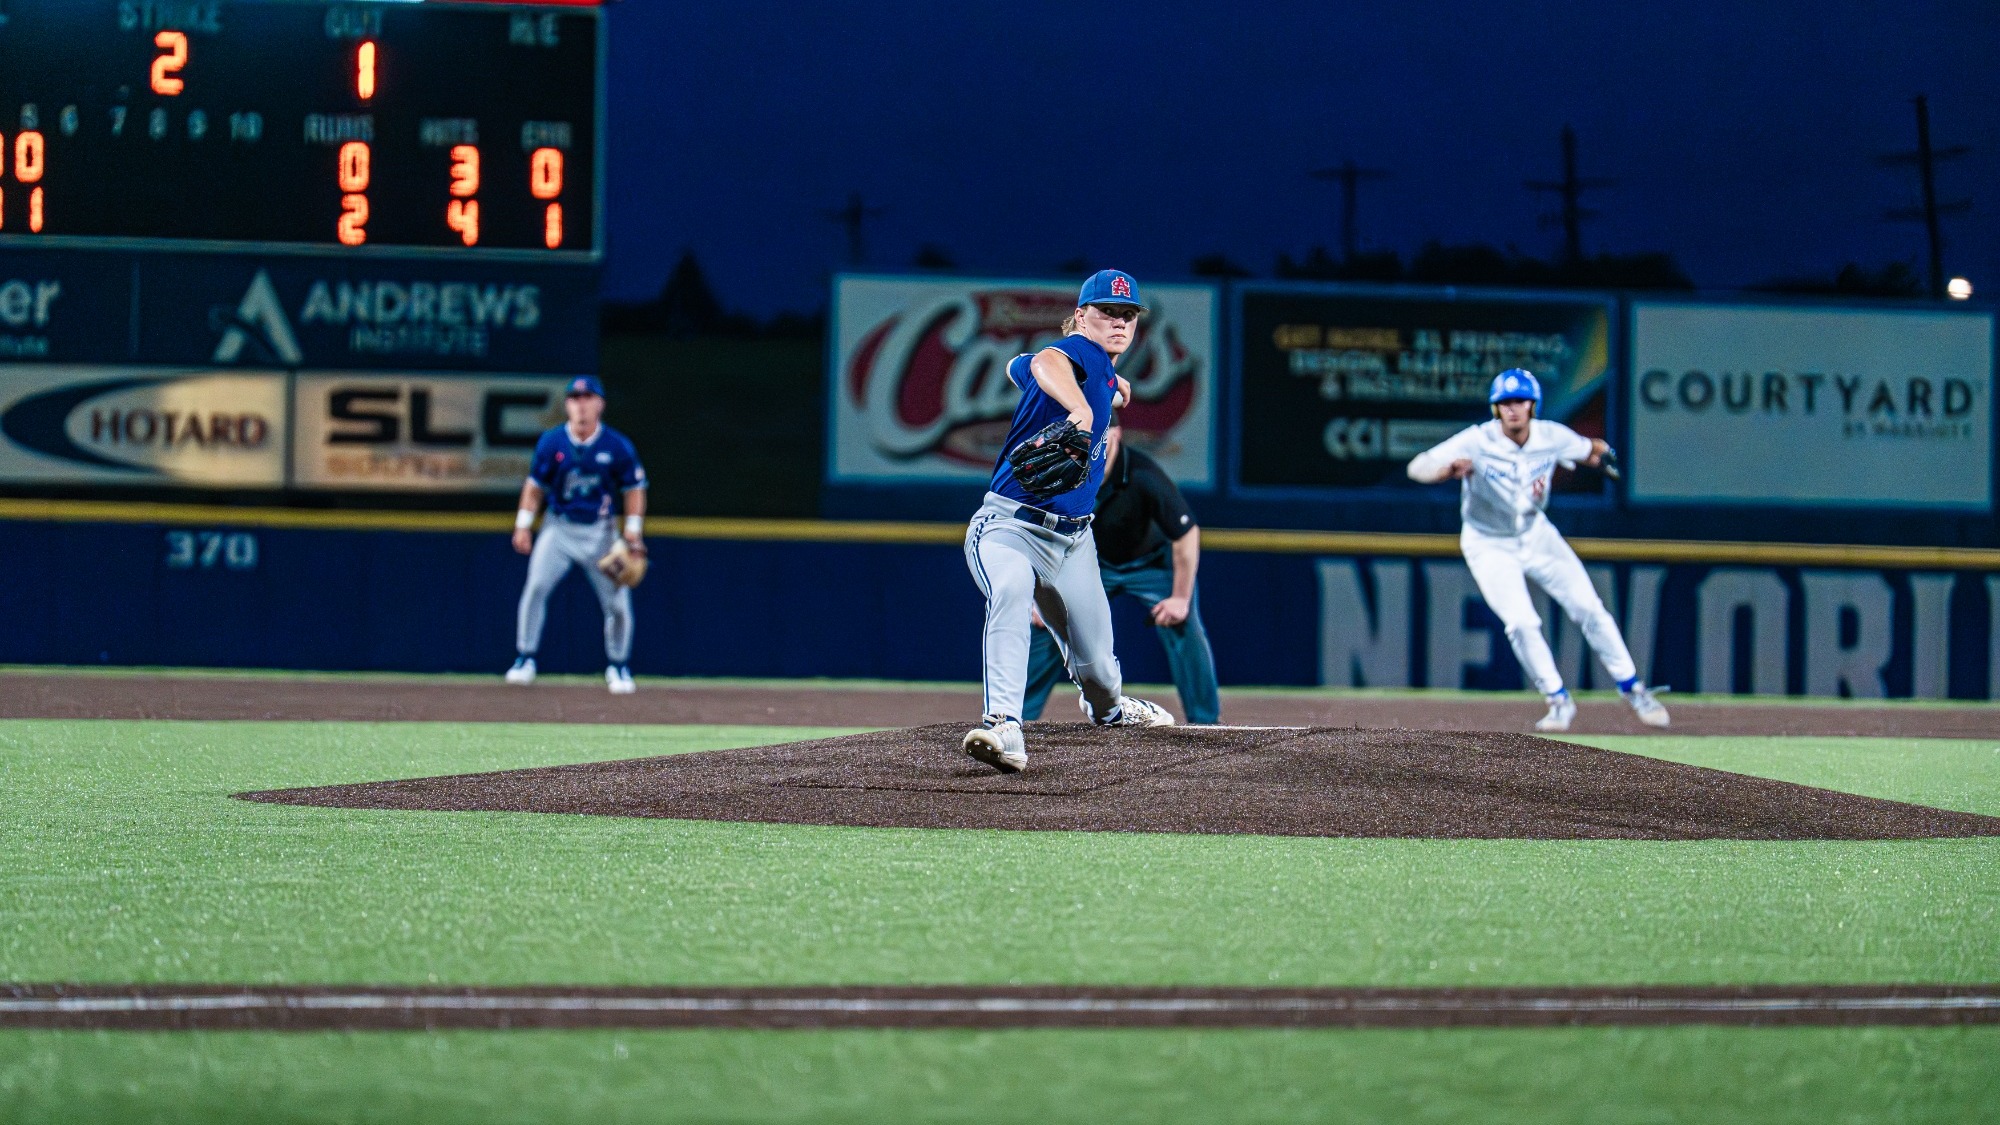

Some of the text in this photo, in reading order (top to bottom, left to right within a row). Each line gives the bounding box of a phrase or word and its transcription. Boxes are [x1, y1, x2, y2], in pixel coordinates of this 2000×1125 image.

[151, 32, 188, 95] 2
[358, 42, 375, 99] 1
[109, 105, 128, 136] 7
[15, 131, 44, 182] 0
[340, 142, 563, 199] 0 3 0
[30, 186, 44, 233] 1
[339, 194, 562, 249] 2 4 1
[303, 281, 540, 328] ANDREWS
[328, 386, 548, 445] SLC
[1640, 370, 1974, 418] COURTYARD
[92, 408, 268, 449] HOTARD
[166, 531, 258, 569] 370
[1318, 561, 1663, 690] NEW
